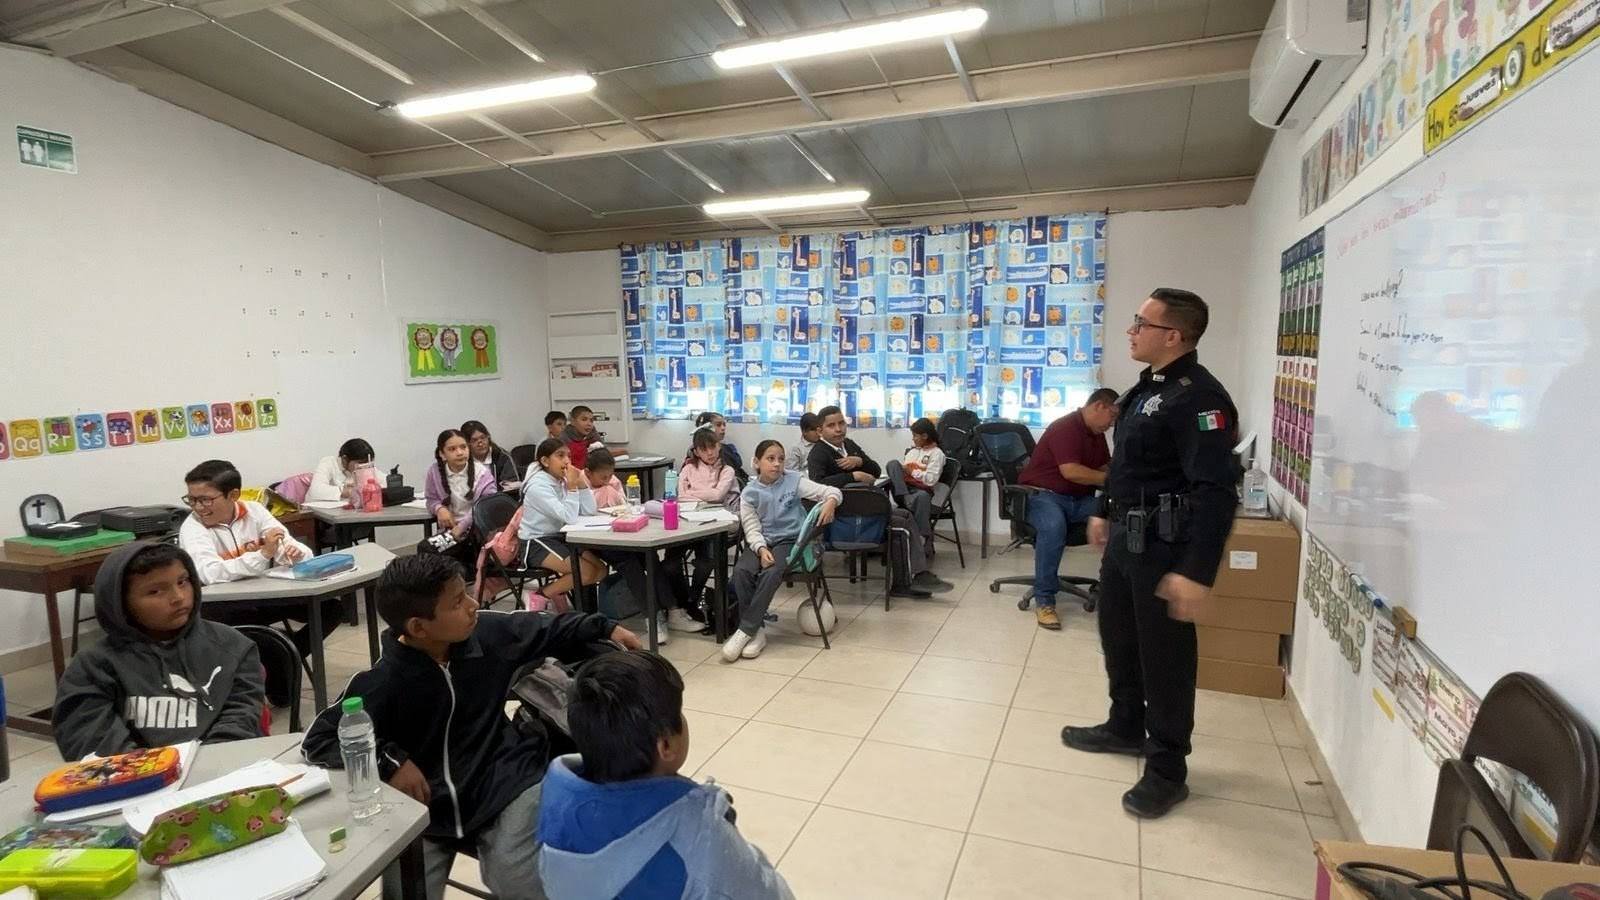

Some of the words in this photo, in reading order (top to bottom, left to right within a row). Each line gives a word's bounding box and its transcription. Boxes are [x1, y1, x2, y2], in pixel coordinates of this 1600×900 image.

[1427, 109, 1445, 144] Hoy
[1464, 77, 1497, 104] Jueves
[13, 436, 42, 454] Qq
[82, 431, 104, 447] Ss
[110, 428, 132, 445] Tt
[163, 421, 186, 434] Vv
[190, 424, 211, 433] Ww
[214, 416, 233, 429] Xx
[238, 414, 253, 428] Yy
[262, 413, 275, 426] Zz
[125, 695, 198, 729] PUMA
